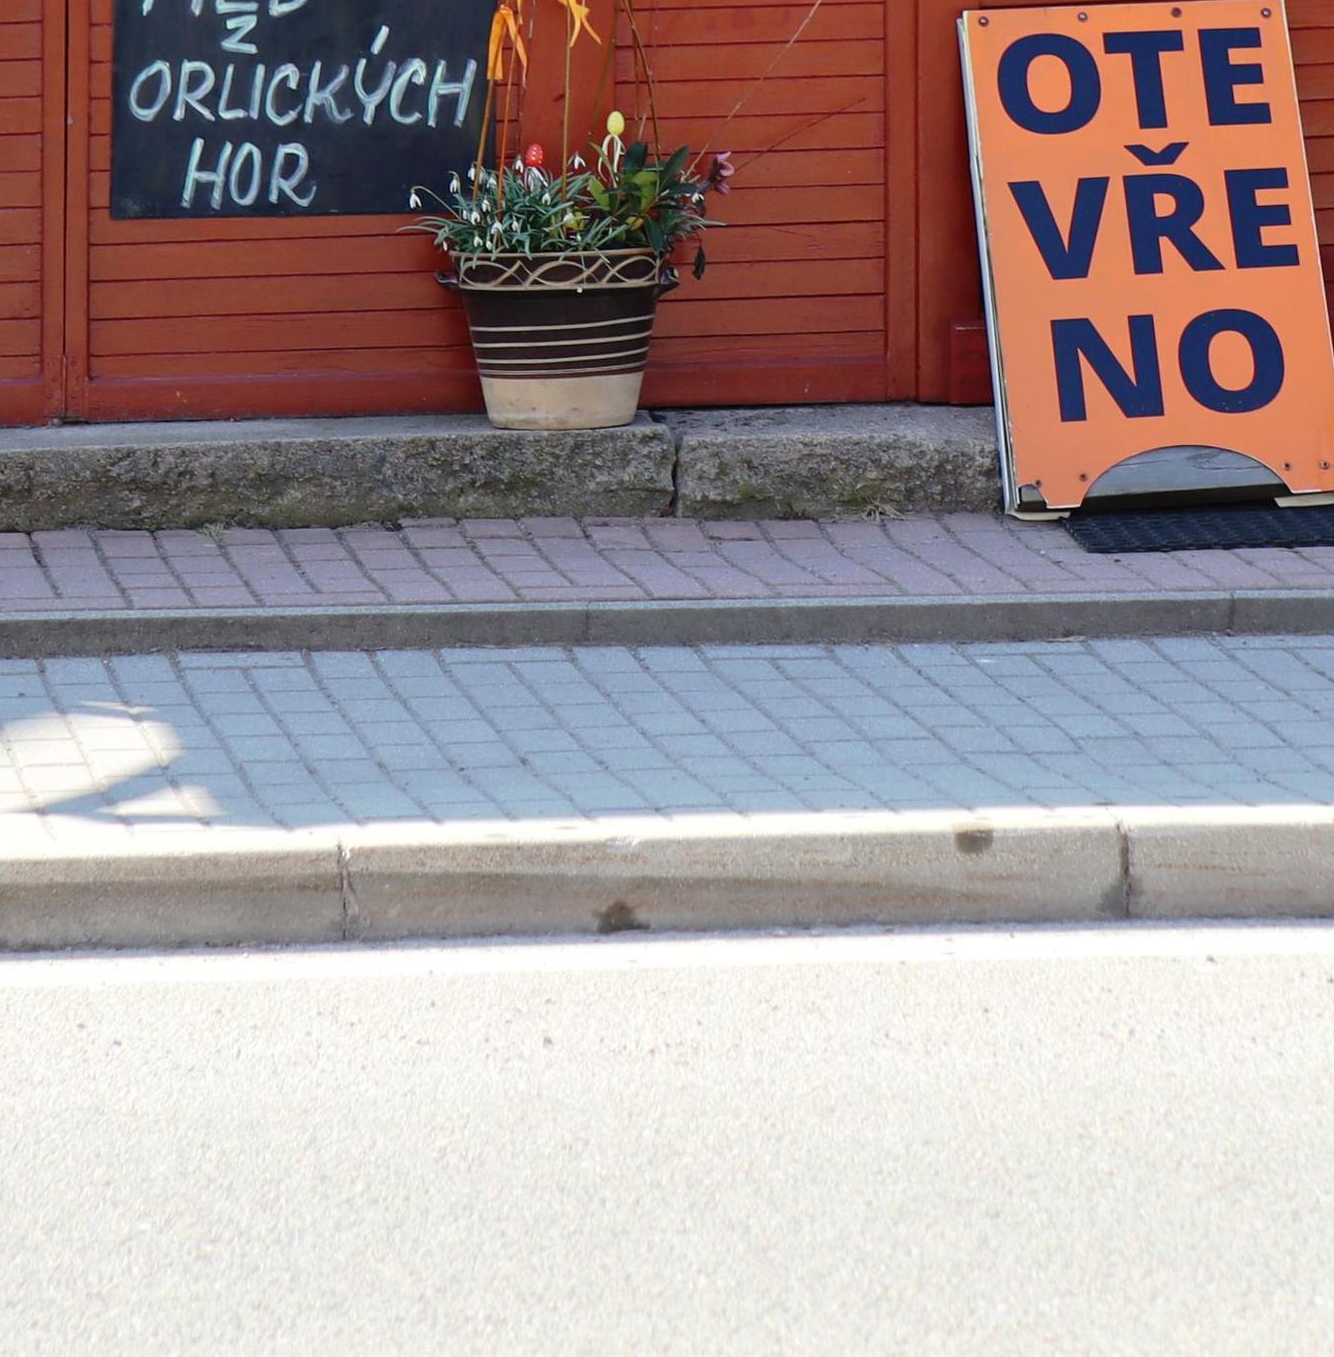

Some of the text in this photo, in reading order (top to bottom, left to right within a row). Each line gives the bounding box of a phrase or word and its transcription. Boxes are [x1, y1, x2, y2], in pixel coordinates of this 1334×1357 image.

[128, 24, 478, 128] ORLICKÝCH
[220, 14, 259, 54] Z
[996, 26, 1273, 135] OTE
[180, 137, 317, 210] HOR
[1007, 141, 1301, 281] VŘE
[1049, 307, 1286, 423] NO
